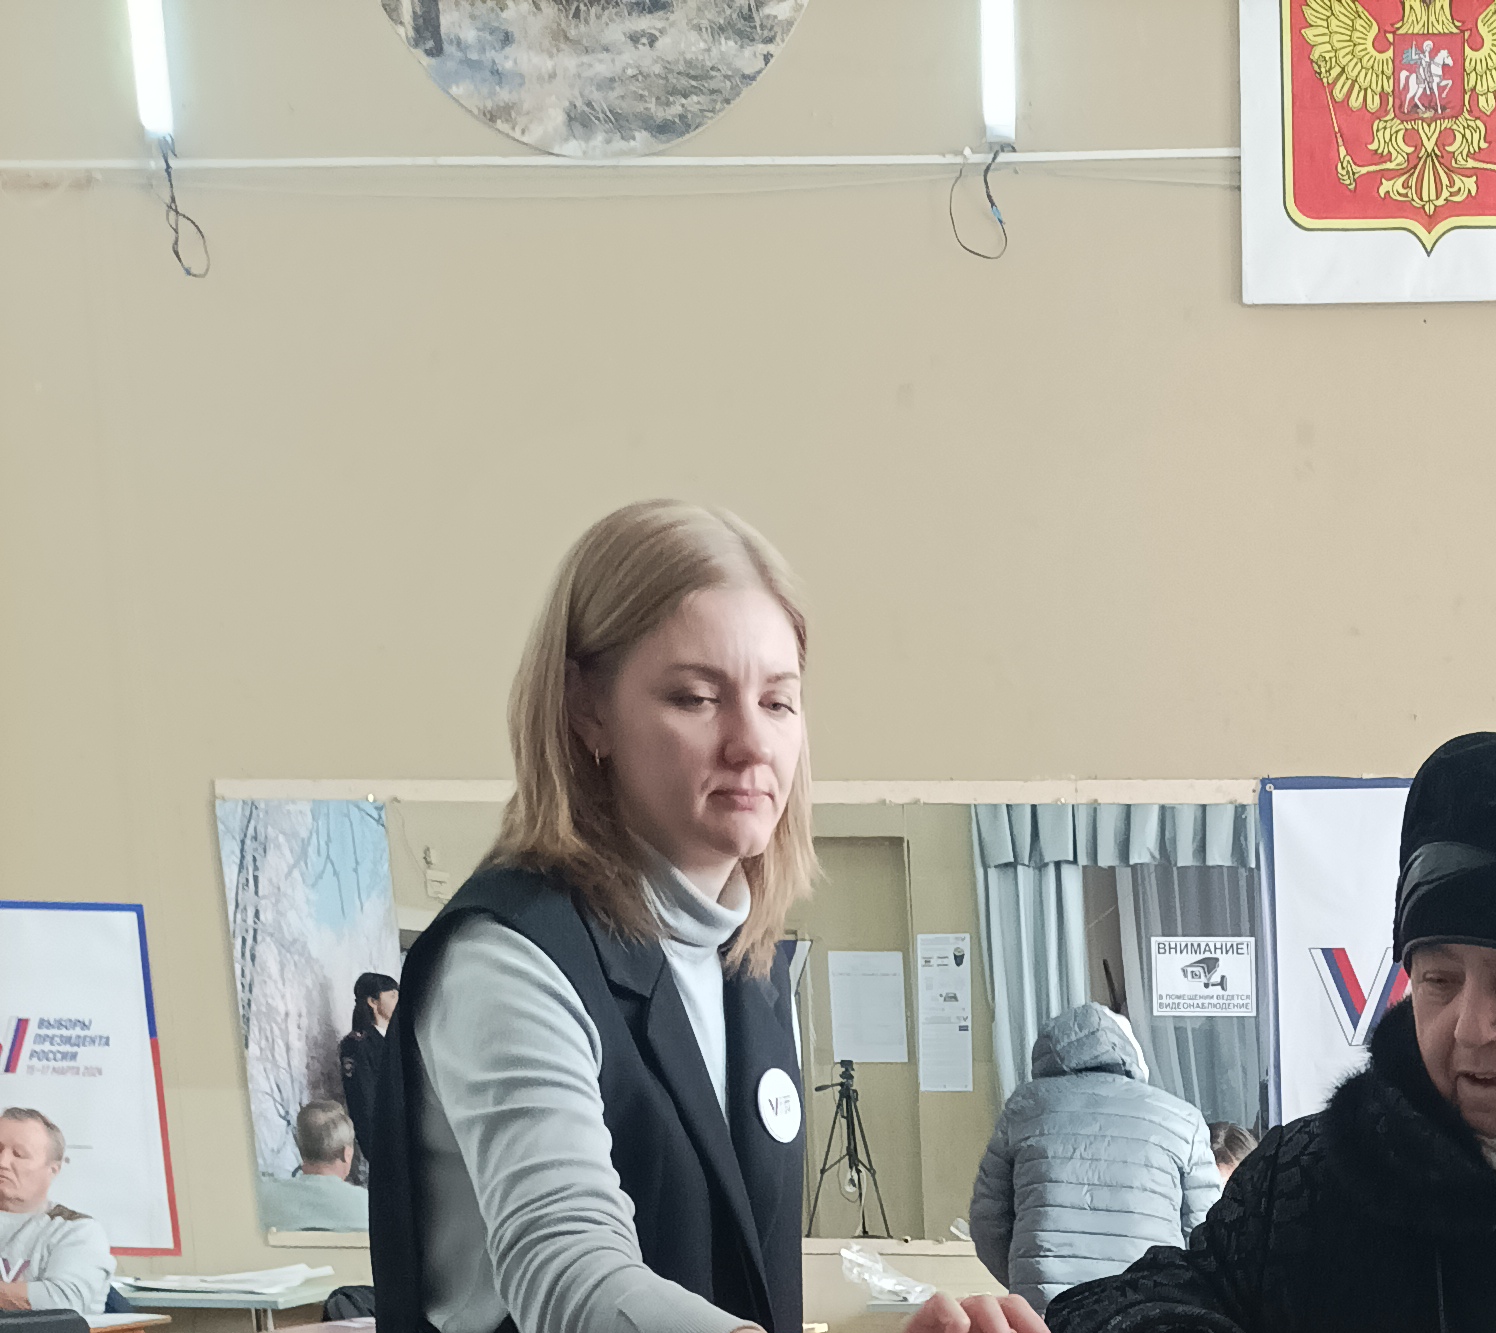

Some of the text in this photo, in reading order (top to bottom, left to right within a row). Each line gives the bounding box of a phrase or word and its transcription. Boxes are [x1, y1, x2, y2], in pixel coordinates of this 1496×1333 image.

[1157, 942, 1250, 955] ВНИМАНИЕ!
[1165, 993, 1214, 1001] ПОМЕЩЕНИИ
[1158, 1002, 1250, 1010] ВИДЕОНАБЛЮДЕНИЕ
[37, 1017, 92, 1031] ВЫБОРЫ
[33, 1033, 110, 1048] ПРЕЗИДЕНТА
[29, 1049, 78, 1062] РОССИИ
